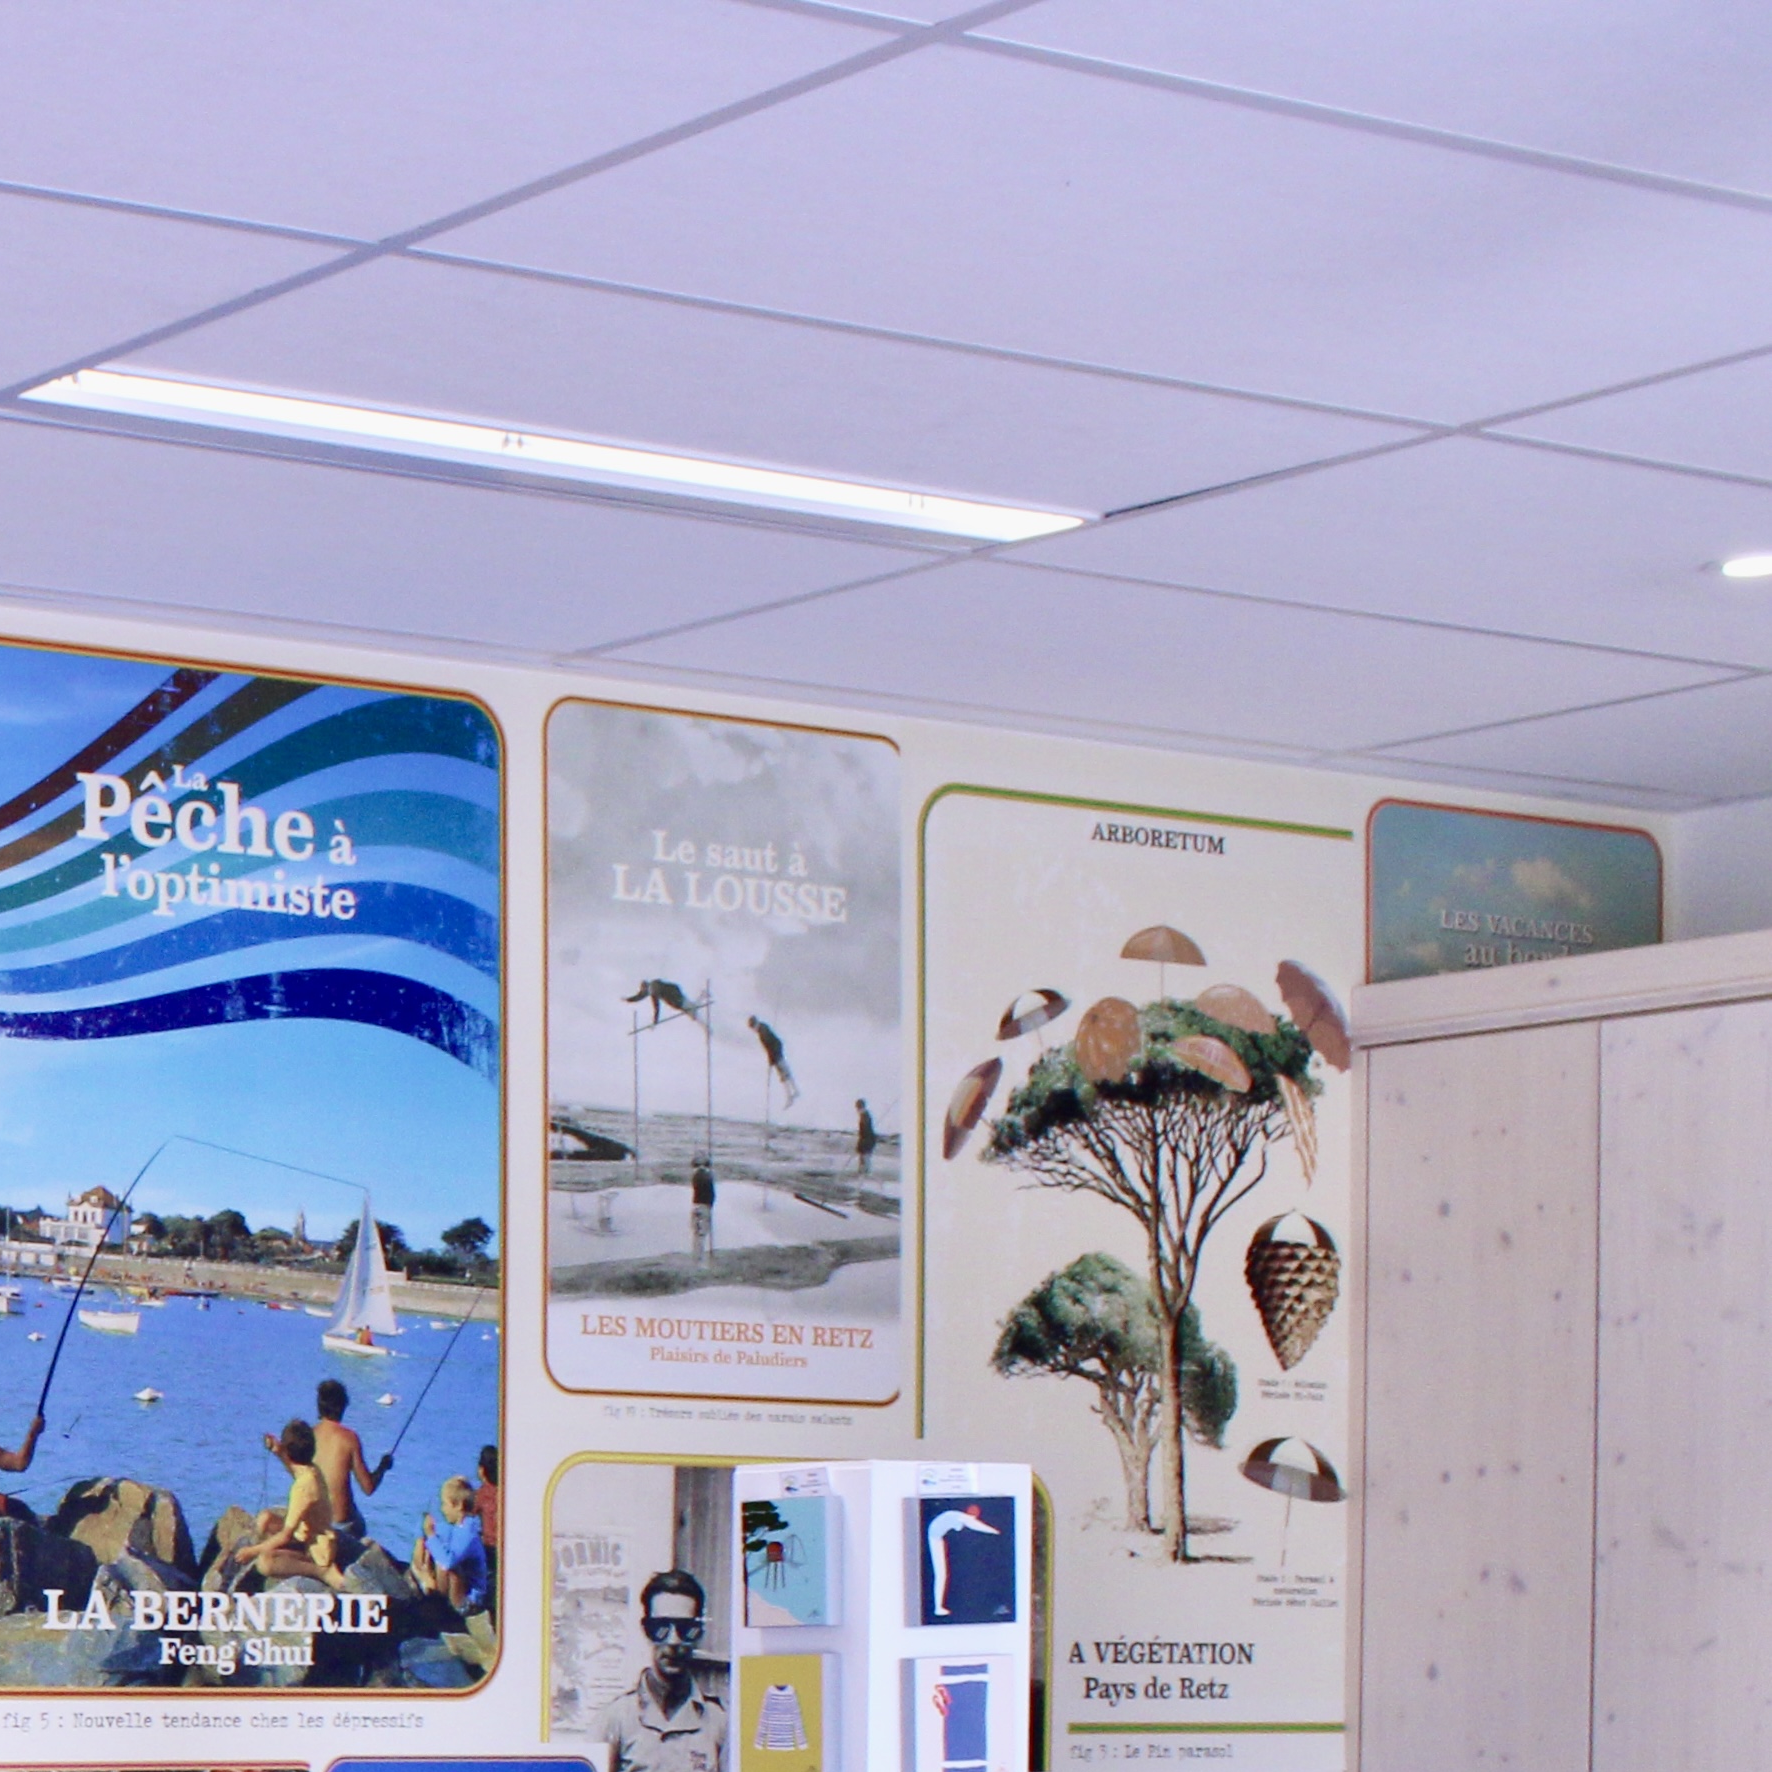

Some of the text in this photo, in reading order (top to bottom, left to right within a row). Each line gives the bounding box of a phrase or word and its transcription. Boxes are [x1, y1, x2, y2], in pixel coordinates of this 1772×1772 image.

[173, 764, 208, 791] La
[76, 771, 355, 866] Pêche à
[653, 830, 808, 877] Le saut à
[1091, 823, 1226, 855] ARBORETUM
[100, 852, 356, 919] l'optimiste
[613, 864, 848, 923] LA LOUSSE
[1441, 909, 1594, 945] LES VACANCES
[1465, 943, 1499, 967] au
[582, 1315, 874, 1349] LES MOUTIERS EN RETZ
[651, 1347, 809, 1368] Plaisirs de Paludiers
[42, 1589, 388, 1634] LA BERNERIE
[158, 1636, 315, 1675] Feng Shui
[1094, 1635, 1255, 1665] VÉGÉTATION
[1084, 1677, 1229, 1707] Pays de Retz
[2, 1711, 424, 1732] fig 5 Nouvelle tendance chez les dépressifs
[1069, 1743, 1092, 1761] fig
[1124, 1743, 1140, 1759] Le
[1148, 1743, 1172, 1759] Pin
[1178, 1742, 1234, 1763] parasol
